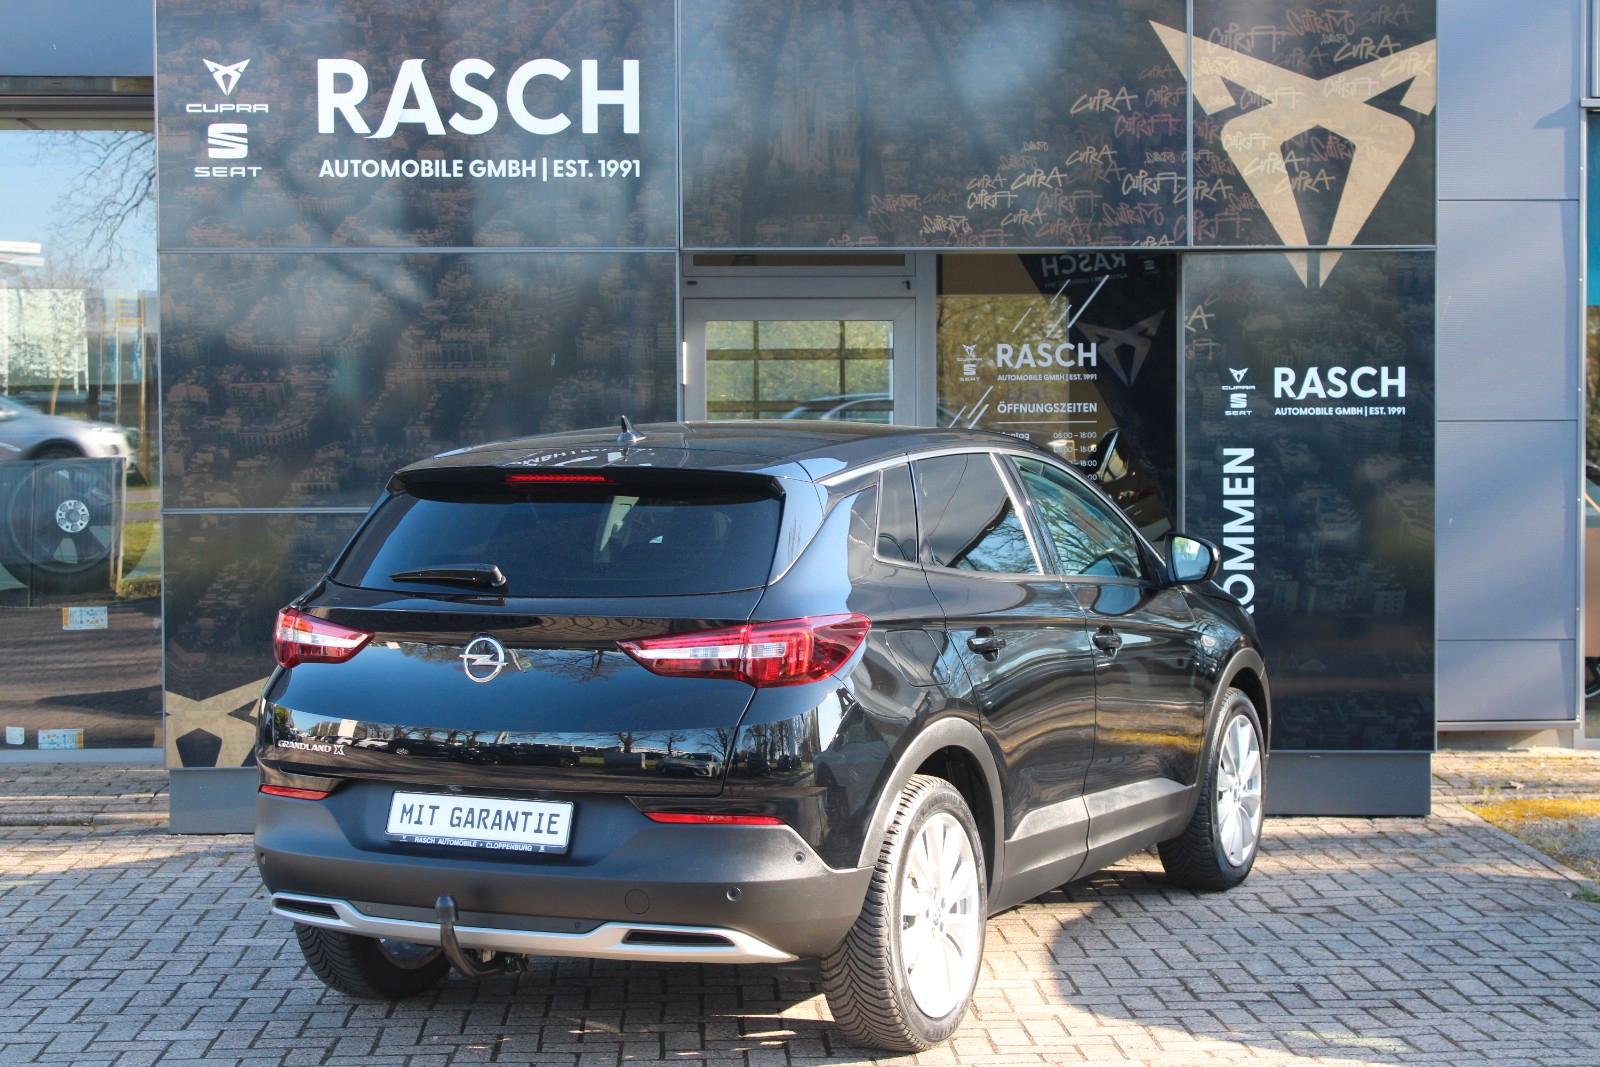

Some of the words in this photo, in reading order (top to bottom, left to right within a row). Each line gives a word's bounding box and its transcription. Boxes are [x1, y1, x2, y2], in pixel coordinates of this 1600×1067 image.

[1333, 35, 1400, 62] CUPRA
[186, 103, 269, 113] CUPRA
[317, 58, 640, 139] RASCH
[1070, 86, 1138, 115] CUPRA
[1065, 144, 1117, 167] CUPRA
[194, 166, 262, 178] SEAT
[318, 158, 464, 178] AUTOMOBILE
[468, 158, 537, 178] GMBH
[553, 158, 594, 178] EST.
[597, 158, 640, 178] 1991
[1011, 166, 1068, 190] CUPRA
[1000, 208, 1047, 226] CUPRA
[996, 342, 1097, 369] RASCH
[997, 374, 1042, 382] AUTOMOBILE
[1043, 374, 1065, 382] GMBH
[1084, 373, 1097, 381] 1991
[1274, 366, 1406, 400] RASCH
[997, 401, 1098, 414] ÖFFNUNGSZEITEN
[1274, 407, 1334, 416] AUTOMOBILE
[1335, 407, 1363, 416] GMBH
[1370, 407, 1386, 416] EST.
[1388, 407, 1406, 416] 1991
[1222, 448, 1255, 614] OMMEN
[277, 740, 332, 753] GRANDLAND
[333, 744, 345, 756] X
[400, 803, 441, 826] MIT
[449, 806, 561, 835] GARANTIE
[414, 836, 436, 844] RASCH
[437, 837, 477, 847] AUTOMOBILE
[485, 841, 533, 851] CLOPPENBURG
